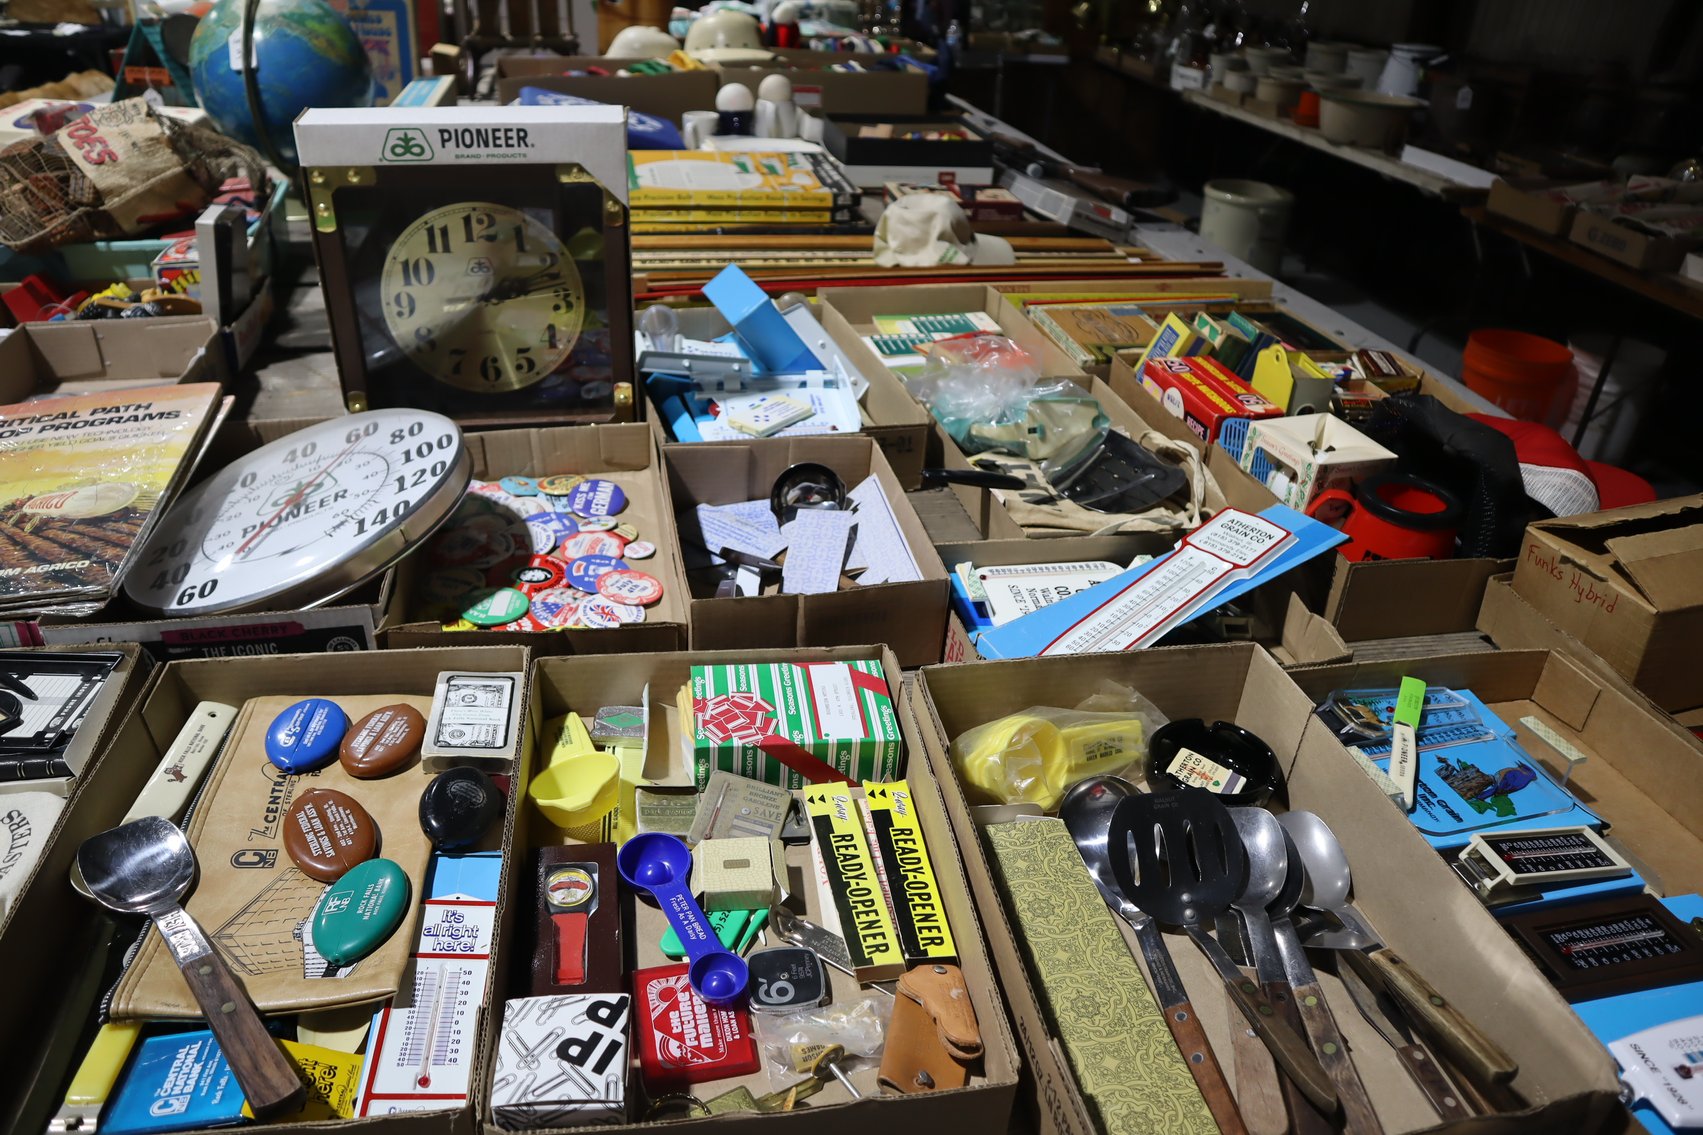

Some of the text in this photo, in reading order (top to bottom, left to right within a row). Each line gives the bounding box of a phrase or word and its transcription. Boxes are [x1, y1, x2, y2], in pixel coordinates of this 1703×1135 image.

[438, 128, 529, 149] PIONEER
[485, 152, 528, 160] PRODUCTS
[425, 223, 453, 254] 11
[461, 213, 497, 243] 12
[513, 225, 528, 253] 1
[401, 257, 435, 287] 10
[394, 291, 416, 320] 9
[552, 287, 574, 315] 3
[414, 327, 437, 353] 8
[540, 324, 561, 349] 4
[450, 350, 467, 375] 7
[480, 356, 503, 383] 6
[515, 347, 536, 375] 5
[38, 410, 182, 434] PROGRAMS
[89, 402, 153, 417] PATH
[345, 421, 379, 445] 60
[389, 421, 424, 446] 80
[1186, 416, 1206, 439] RECIPE
[282, 442, 317, 464] 40
[401, 433, 454, 466] 100
[393, 460, 448, 495] 120
[572, 482, 591, 510] KISS ME
[590, 480, 615, 515] GERMAN
[240, 488, 349, 539] PIONEER
[353, 499, 411, 538] 140
[1220, 522, 1250, 539] GRAIN
[1228, 518, 1275, 541] ATHERTON
[23, 560, 91, 575] AGRICO
[150, 562, 191, 591] 40
[1527, 544, 1620, 614] Funks Hybrid
[176, 578, 219, 607] 60
[616, 579, 635, 592] July
[1007, 584, 1025, 604] SINCE
[180, 624, 288, 642] BLACK CHERRY
[202, 642, 278, 658] THE ICONIC
[739, 665, 748, 692] Seasons
[786, 687, 797, 715] Seasons
[880, 704, 896, 740] Greetings
[1401, 742, 1409, 764] PIONEER
[1181, 766, 1197, 783] GRAIN
[263, 769, 288, 824] CENTRA
[310, 818, 324, 832] LOAN
[753, 806, 783, 821] SAVE
[1436, 799, 1464, 823] Grain
[0, 808, 32, 880] ASTERS
[295, 810, 323, 857] STERLING FEDERAL
[319, 835, 336, 859] SAVINGS
[356, 883, 375, 915] ROCK FALLS
[362, 878, 385, 921] NATIONAL BANK
[830, 832, 890, 956] READY-OPENER
[890, 827, 945, 948] READY-OPENER
[442, 909, 465, 923] It's
[669, 897, 681, 913] Fresh
[678, 912, 685, 920] As
[685, 924, 697, 940] Daisy
[675, 893, 707, 941] PETER PAN BREAD
[160, 910, 200, 959] HEY BROS
[432, 938, 477, 953] here!
[678, 991, 699, 1047] FUTURE
[720, 1010, 733, 1042] DIXON HOM
[730, 1021, 739, 1034] LOAN
[160, 1044, 190, 1097] CENTRAL
[170, 1040, 203, 1096] NATIONAL
[1628, 1042, 1662, 1074] SINCE
[182, 1061, 204, 1094] BANK
[316, 1061, 338, 1104] here!
